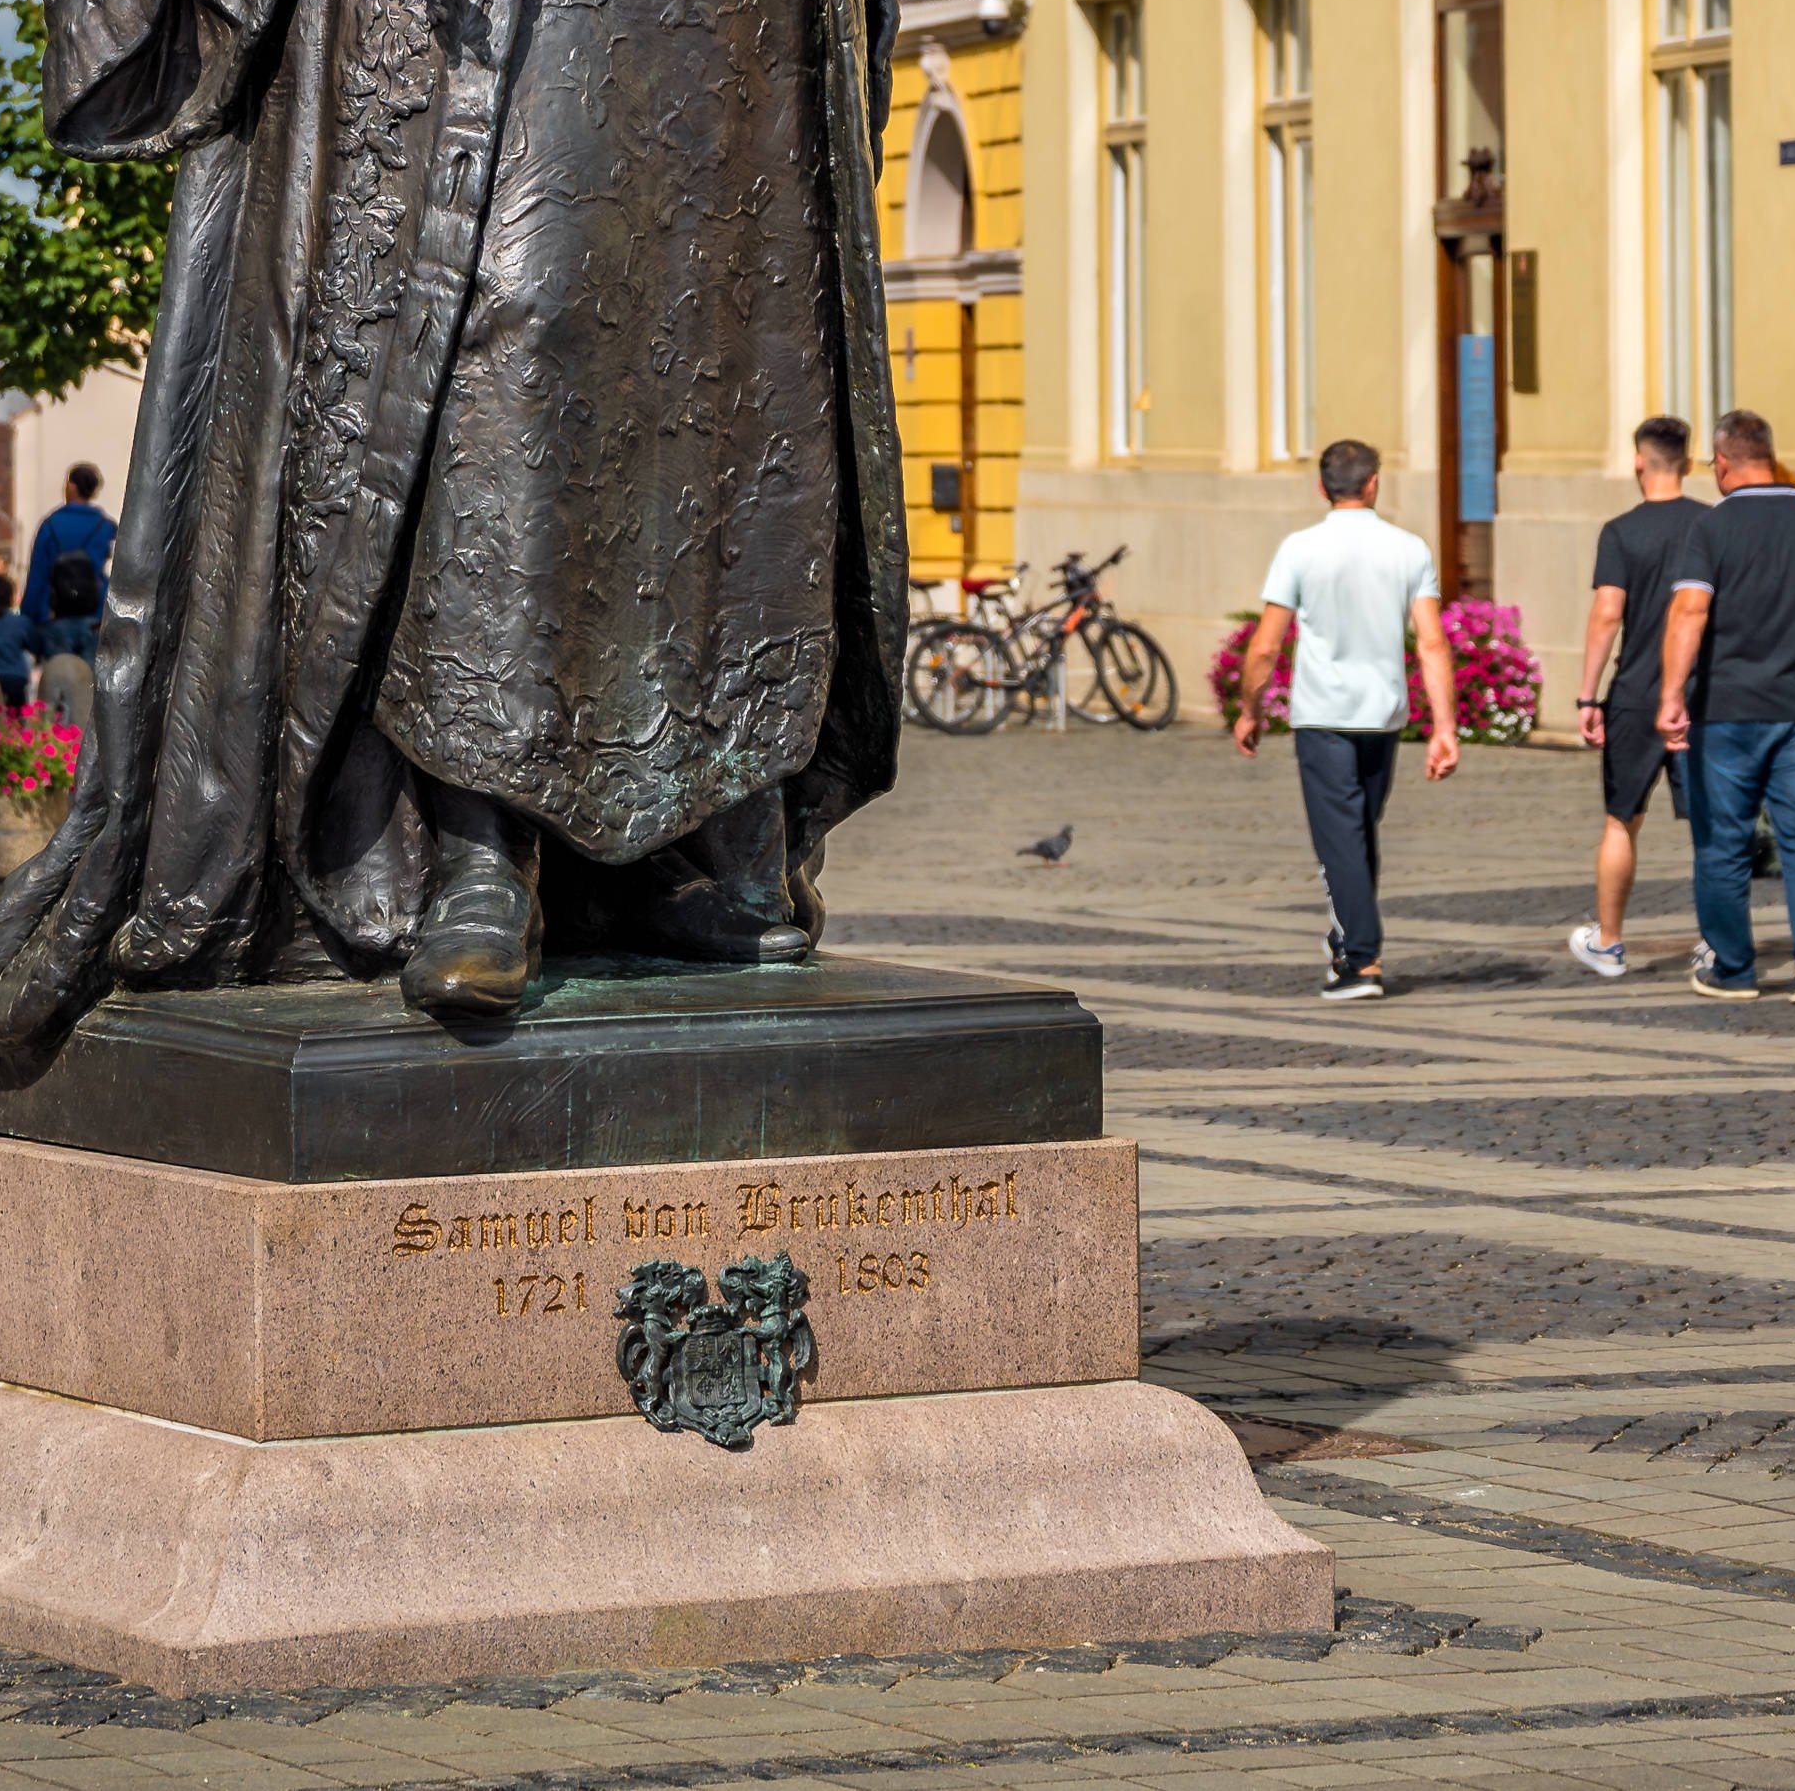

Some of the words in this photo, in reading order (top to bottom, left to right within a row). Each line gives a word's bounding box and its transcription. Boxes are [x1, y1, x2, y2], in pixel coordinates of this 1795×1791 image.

[392, 1195, 599, 1257] Samuel
[624, 1196, 709, 1242] von
[736, 1169, 1019, 1241] Brukenthal
[493, 1272, 588, 1318] 1721
[836, 1250, 931, 1295] 1803
